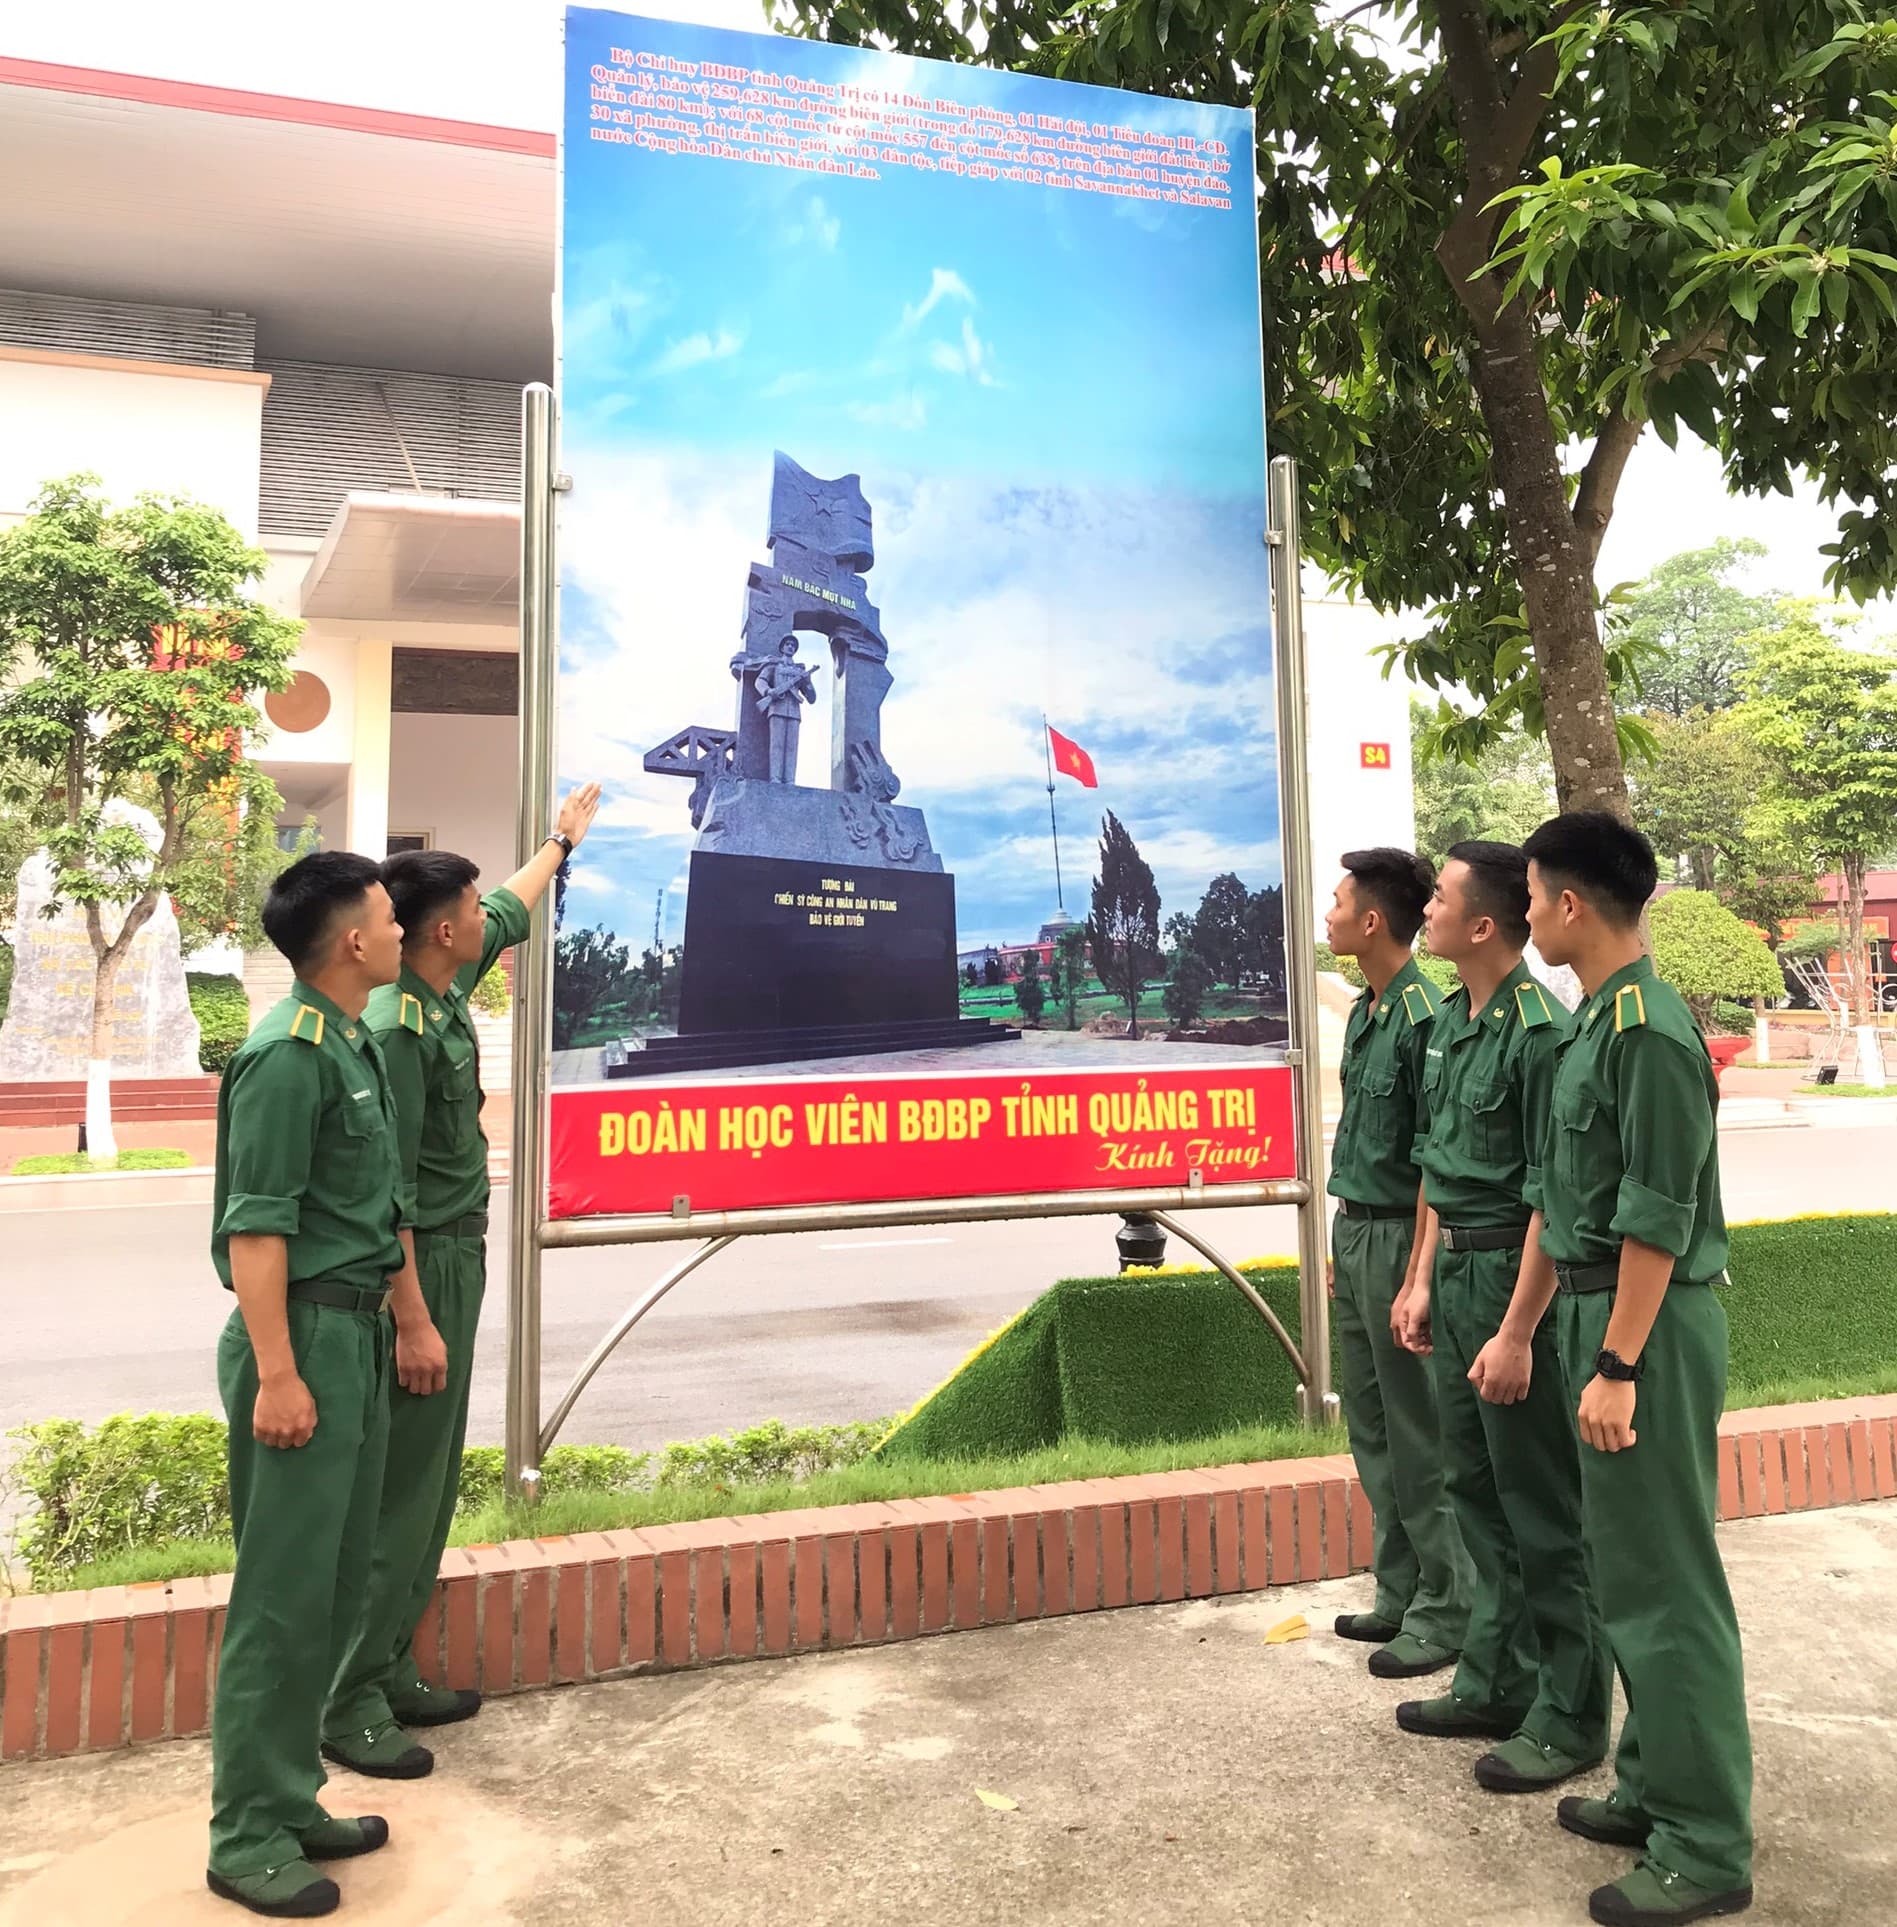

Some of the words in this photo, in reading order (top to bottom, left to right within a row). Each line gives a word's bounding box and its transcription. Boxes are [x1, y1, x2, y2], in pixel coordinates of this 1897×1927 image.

[656, 94, 676, 110] 80
[745, 109, 763, 123] 68
[902, 132, 928, 148] 557
[1144, 167, 1158, 182] 01
[772, 93, 797, 109] km
[1032, 132, 1055, 149] km
[884, 91, 898, 105] 14
[1019, 112, 1034, 127] 01
[1092, 123, 1107, 139] 01
[591, 104, 611, 121] 30
[860, 146, 878, 160] 03
[1025, 168, 1042, 184] 02
[1074, 175, 1160, 200] Savannakhet
[1180, 190, 1232, 209] Salavan
[782, 574, 802, 589] NAM
[1365, 746, 1386, 764] S4
[824, 896, 834, 908] AN
[599, 1101, 706, 1156] ĐOÀN
[719, 1104, 793, 1159] HỌC
[805, 1093, 887, 1146] VIÊN
[900, 1098, 991, 1142] BĐBP
[1001, 1082, 1078, 1137] TỈNH
[1089, 1078, 1198, 1138] QUẢNG
[1207, 1088, 1255, 1136] TRỊ
[1095, 1140, 1175, 1171] Kính
[1185, 1136, 1272, 1172] Tặng!
